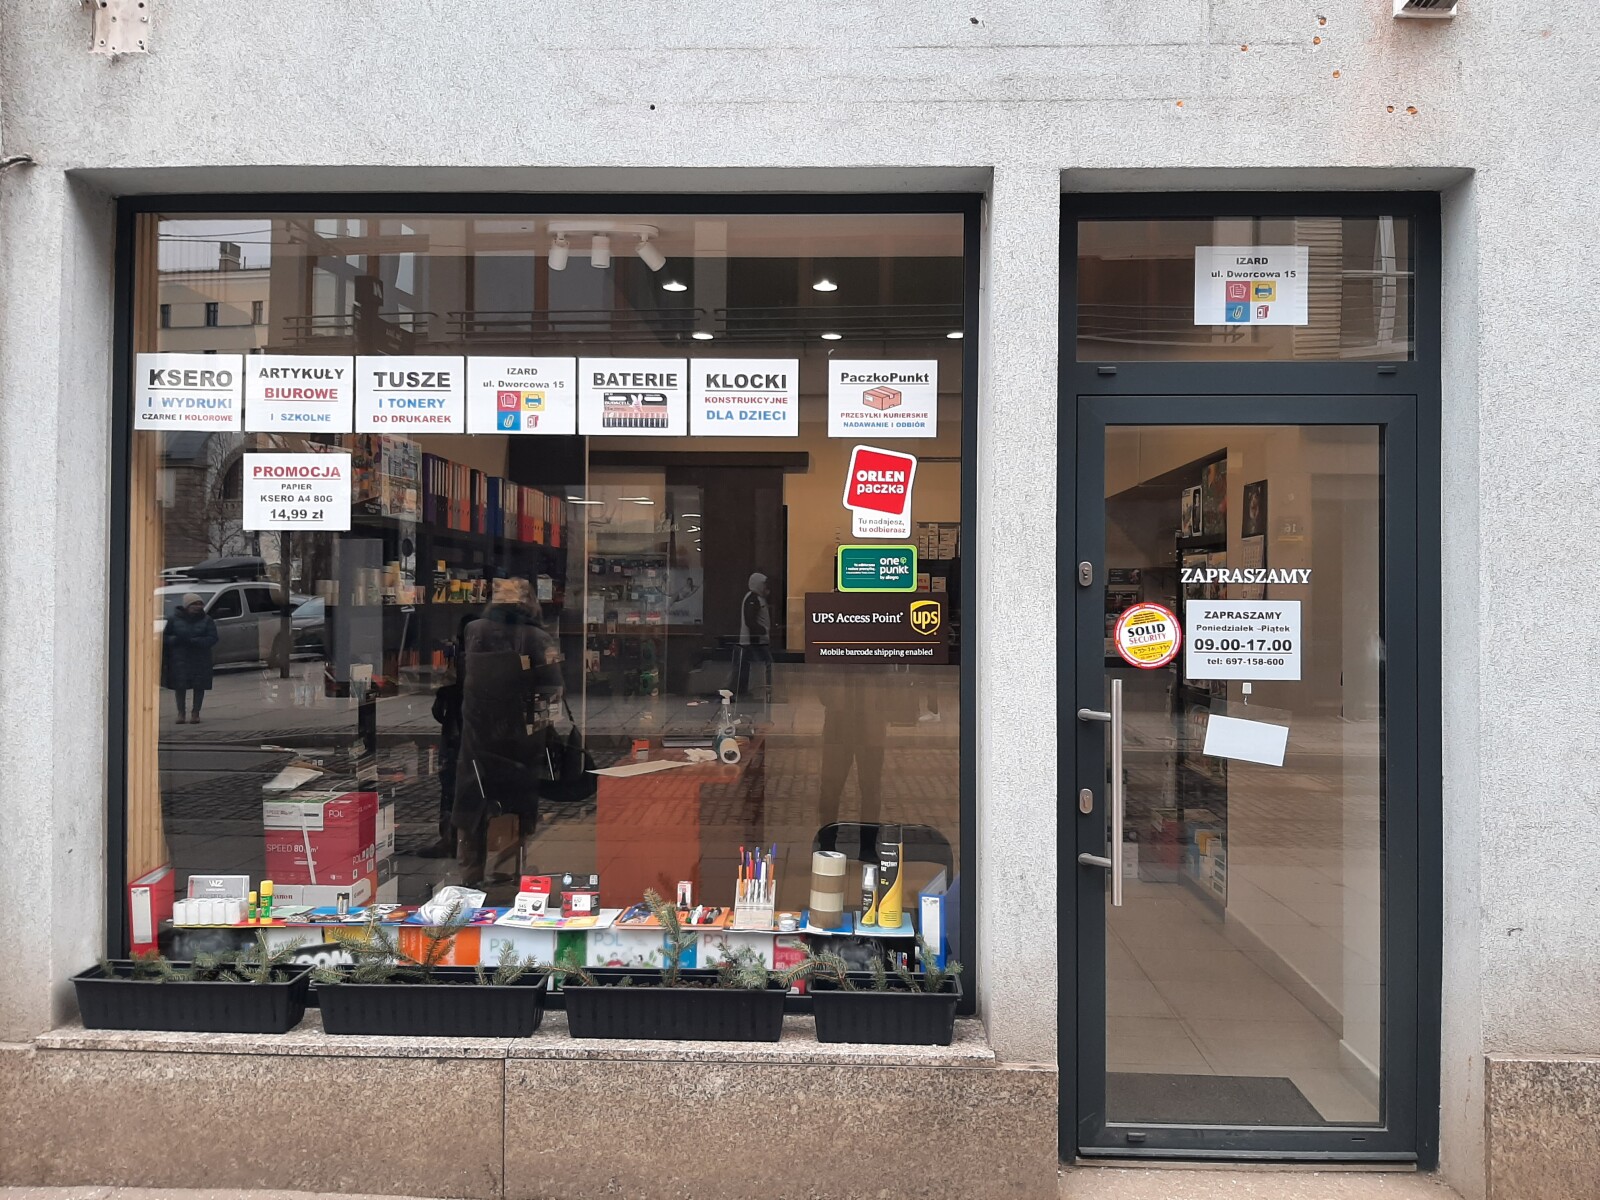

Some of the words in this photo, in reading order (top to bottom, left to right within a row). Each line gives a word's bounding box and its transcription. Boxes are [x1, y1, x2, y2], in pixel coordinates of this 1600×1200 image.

[1236, 257, 1268, 265] IZARD
[1211, 270, 1223, 278] ul.
[1227, 270, 1280, 278] Dworcowa
[1285, 270, 1296, 278] 15
[259, 367, 344, 380] ARTYKUŁY
[507, 367, 538, 376] IZARD
[149, 368, 233, 388] KSERO
[373, 371, 451, 388] TUSZE
[593, 372, 678, 388] BATERIE
[706, 373, 787, 389] KLOCKI
[841, 372, 930, 383] PaczkoPunkt
[483, 380, 495, 388] ul.
[498, 380, 550, 388] Dworcowa
[553, 381, 564, 389] 15
[264, 387, 338, 399] BIUROWE
[148, 397, 152, 408] I
[162, 397, 232, 409] WYDRUKI
[378, 398, 382, 409] I
[389, 398, 446, 409] TONERY
[704, 396, 788, 405] KONSTRUKCYJNE
[142, 413, 177, 421] CZARNE
[184, 414, 233, 422] KOLOROWE
[270, 413, 274, 421] I
[280, 413, 331, 422] SZKOLNE
[373, 414, 387, 423] DO
[391, 414, 451, 423] DRUKAREK
[706, 410, 734, 421] DLA
[739, 410, 787, 422] DZIECI
[896, 420, 925, 428] ODBIÓR
[253, 466, 341, 478] PROMOCJA
[856, 470, 905, 482] ORLEN
[857, 483, 905, 495] paczka
[260, 494, 295, 502] KSERO
[269, 509, 307, 521] 14,99
[312, 509, 324, 519] zł
[869, 518, 905, 526] nadajesz,
[869, 526, 906, 534] odbierasz
[880, 557, 899, 565] one
[880, 565, 909, 575] punkt
[1180, 568, 1311, 584] ZAPRASZAMY
[812, 613, 834, 623] UPS
[836, 613, 870, 623] Access
[872, 612, 901, 623] Point
[913, 611, 938, 630] ups
[1204, 611, 1282, 620] ZAPRASZAMY
[1127, 623, 1166, 638] SOLID
[1128, 632, 1167, 645] SECURITY
[1194, 638, 1292, 651] 09.00-17.00
[820, 648, 845, 656] Mobile
[846, 648, 873, 656] barcode
[874, 648, 905, 657] shipping
[905, 648, 933, 656] enabled
[1226, 658, 1284, 666] 697-158-600
[266, 844, 292, 853] SPEED
